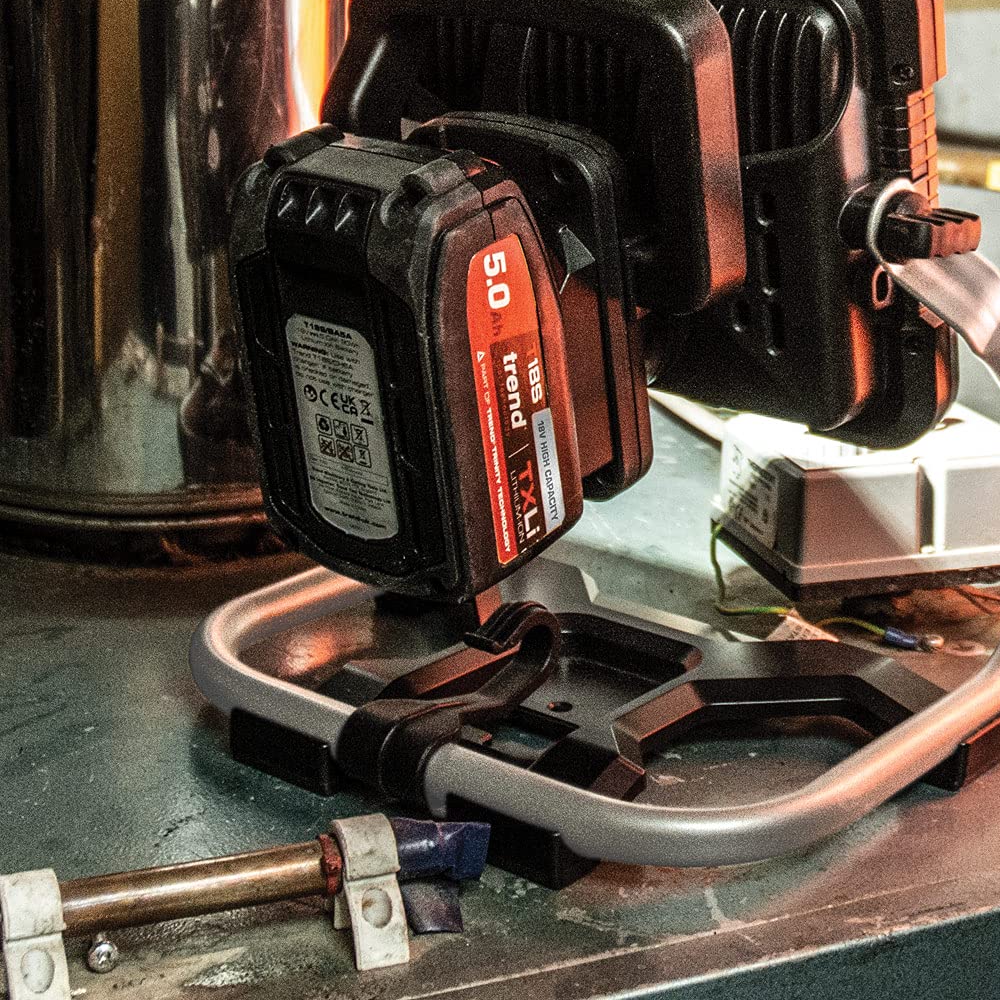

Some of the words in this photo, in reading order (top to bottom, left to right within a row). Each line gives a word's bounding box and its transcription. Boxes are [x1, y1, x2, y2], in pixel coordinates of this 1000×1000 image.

[483, 251, 511, 310] 5.0
[490, 312, 503, 337] Ah
[480, 362, 489, 389] PART
[503, 351, 527, 430] trend
[484, 391, 491, 406] OF
[537, 420, 546, 438] 18V
[492, 445, 502, 484] TRINITY
[540, 441, 550, 468] HIGH
[518, 459, 540, 540] TXLi
[544, 469, 559, 521] CAPACITY
[498, 486, 511, 552] TECHNOLOGY
